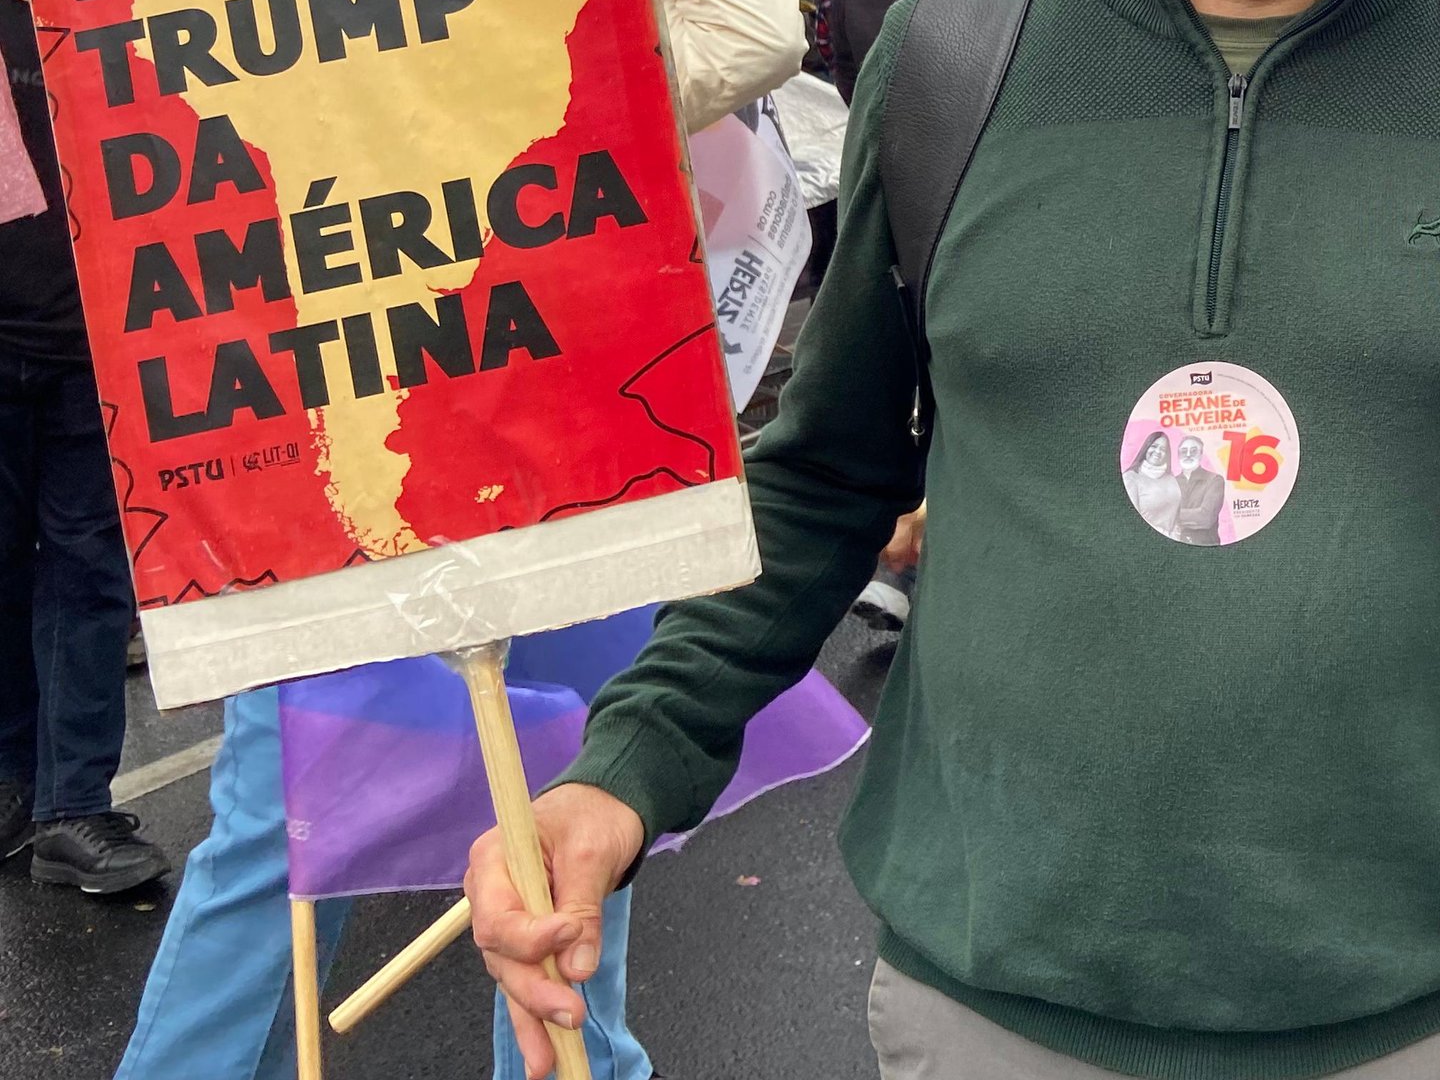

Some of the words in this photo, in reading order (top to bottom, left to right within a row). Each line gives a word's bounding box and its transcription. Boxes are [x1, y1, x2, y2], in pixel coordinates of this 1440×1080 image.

[100, 114, 266, 220] DA
[123, 150, 650, 333] AMÉRICA
[137, 282, 563, 443] LATINA
[1191, 374, 1211, 384] PSTU
[1159, 389, 1213, 399] GOVERNADORA
[1159, 394, 1231, 414] REJANE
[1232, 399, 1246, 407] DE
[1160, 408, 1247, 428] OLIVEIRA
[158, 458, 225, 492] PSTU
[263, 442, 300, 464] LIT-QI
[1223, 431, 1281, 485] 16
[1233, 499, 1260, 510] HERTZ
